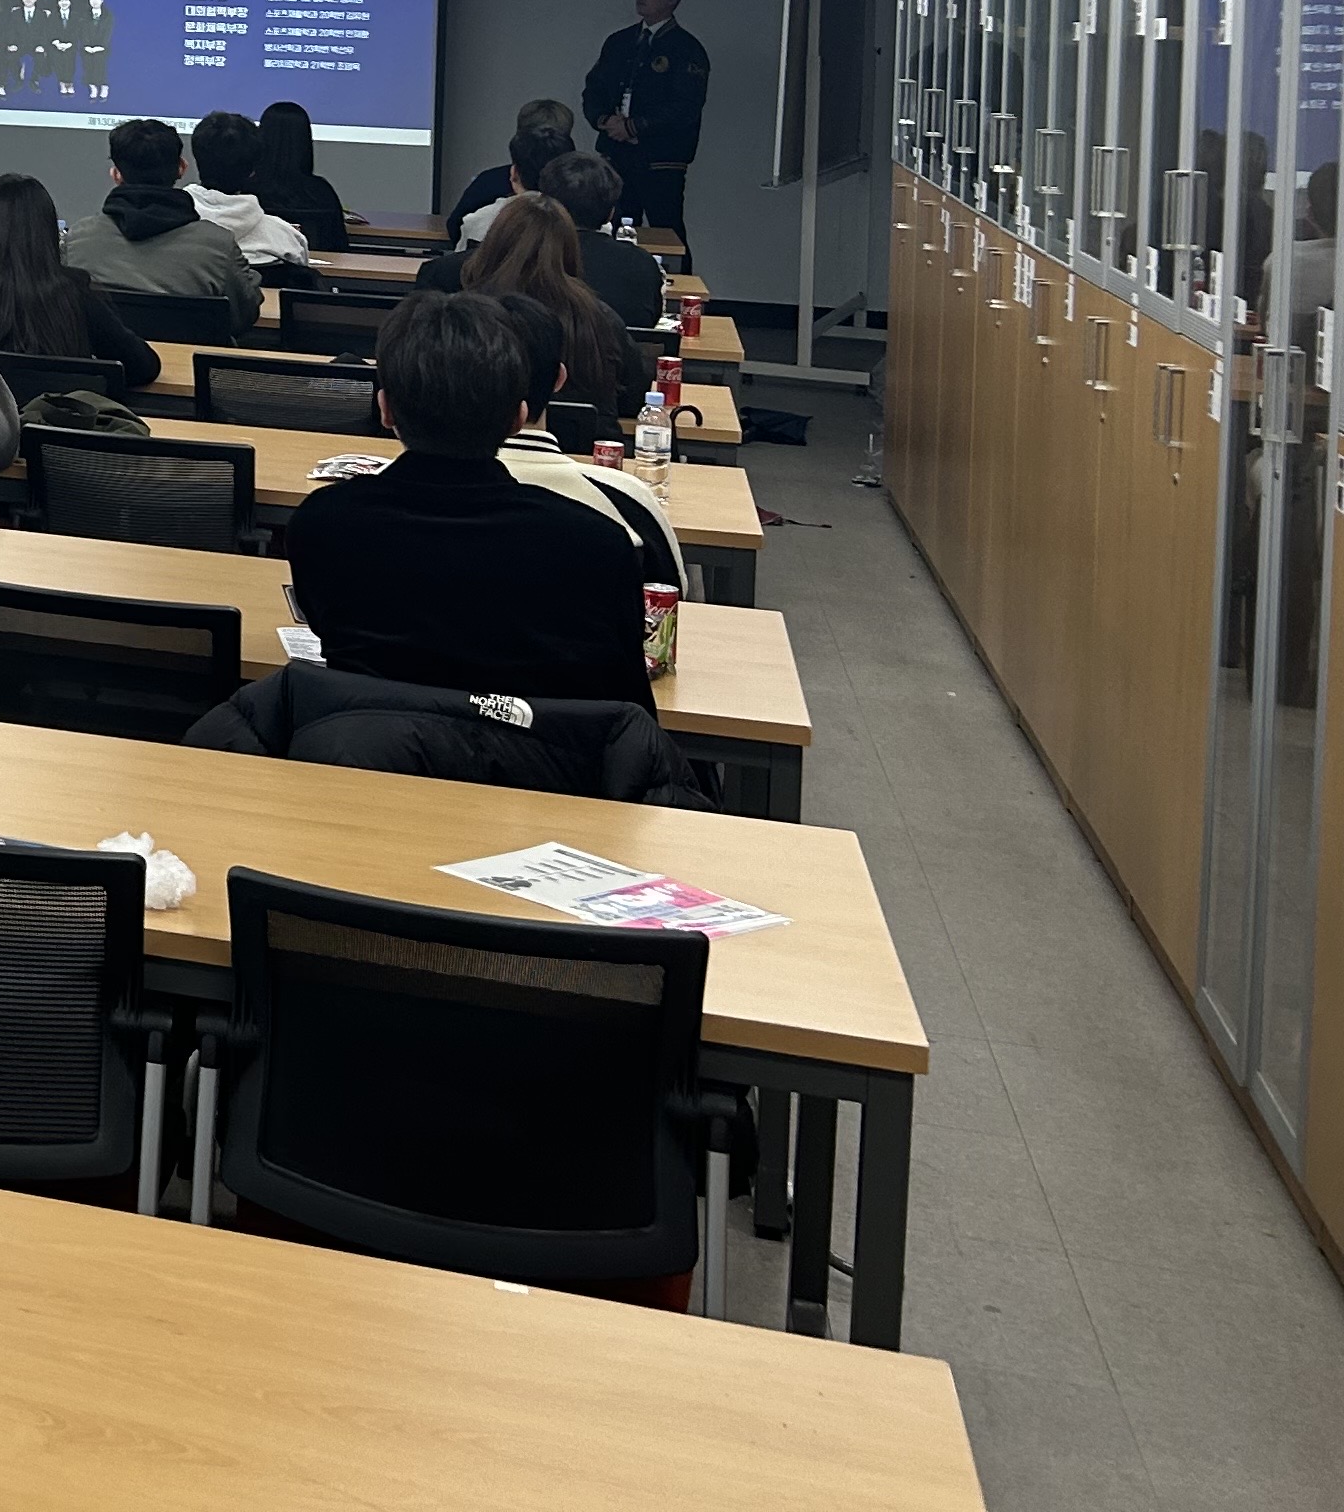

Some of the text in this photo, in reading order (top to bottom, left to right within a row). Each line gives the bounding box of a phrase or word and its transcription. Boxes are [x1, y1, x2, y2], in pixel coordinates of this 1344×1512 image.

[185, 5, 249, 18] 대외협력부장
[185, 22, 248, 35] 문화체육부장
[184, 39, 226, 51] 복지부장
[184, 55, 226, 67] 정책부장
[469, 694, 512, 713] NORTH
[479, 705, 511, 722] FACE
